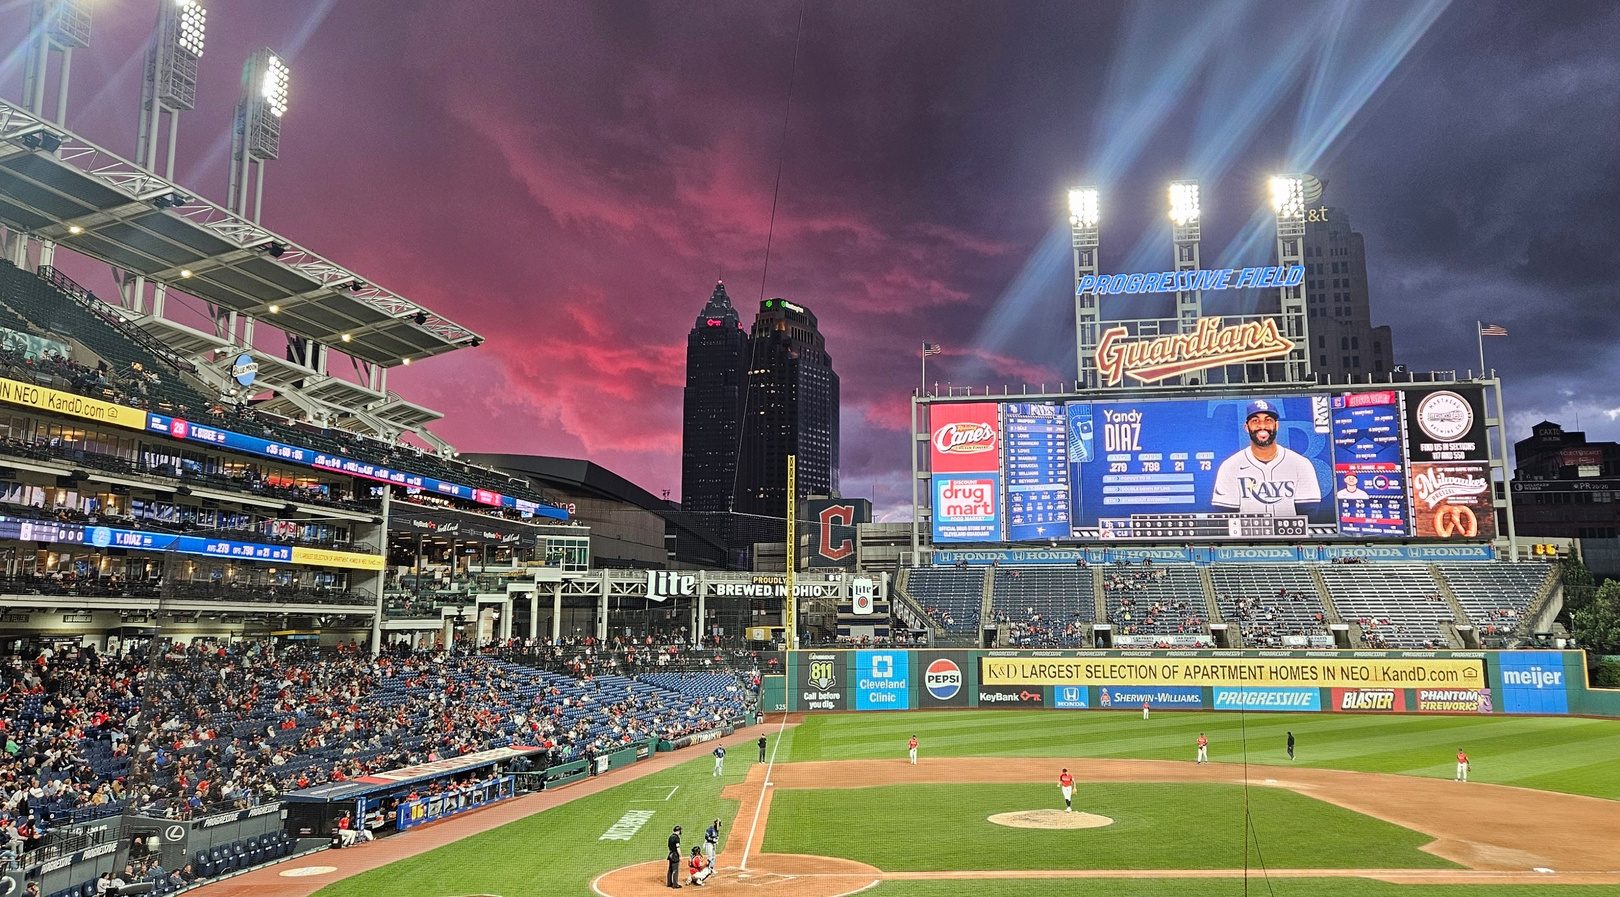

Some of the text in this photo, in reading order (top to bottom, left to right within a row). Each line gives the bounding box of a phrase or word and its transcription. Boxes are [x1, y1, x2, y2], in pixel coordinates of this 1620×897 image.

[1077, 265, 1305, 295] PROGRESSIVE FIELD
[1095, 316, 1295, 386] Guardians
[14, 386, 39, 404] NEO
[48, 392, 105, 418] KandD.com
[1104, 409, 1142, 423] Yandy
[1313, 396, 1330, 428] RAYS
[937, 423, 994, 450] Cane's
[1104, 424, 1142, 451] DIAZ
[1420, 442, 1476, 451] FIND US IN SECTIONS
[1110, 461, 1211, 472] .279 .798 21 73
[1415, 467, 1486, 499] Milwaukee
[943, 480, 984, 503] drug
[1237, 477, 1295, 504] RAYS
[947, 502, 993, 515] mart
[819, 505, 855, 561] C
[953, 552, 1008, 560] HONDA
[1026, 551, 1082, 559] HONDA
[1126, 550, 1185, 558] HONDA
[1233, 549, 1292, 558] HONDA
[1342, 549, 1404, 557] HONDA
[1423, 548, 1487, 556] HONDA
[645, 570, 695, 602] Lite
[753, 577, 787, 585] PROUDLY
[717, 584, 822, 597] BREWED IN OHIO
[855, 585, 872, 596] Lite
[811, 663, 832, 680] 811
[988, 664, 1017, 678] K&D
[1022, 664, 1081, 679] LARGEST
[1085, 664, 1158, 679] SELECTION
[1161, 665, 1179, 679] OF
[1183, 665, 1265, 680] APARTMENT
[1269, 665, 1318, 680] HOMES
[1323, 666, 1336, 680] IN
[1341, 666, 1370, 680] NEO
[1382, 666, 1458, 682] KandD.com
[1504, 667, 1561, 688] meijer
[860, 679, 906, 689] Cleveland
[928, 675, 960, 683] PEPSI
[804, 692, 841, 700] Call before
[869, 693, 896, 702] Clinic
[980, 692, 1019, 702] KeyBank
[1216, 691, 1313, 706] PROGRESSIVE
[1342, 691, 1394, 709] BLASTER
[1420, 690, 1478, 701] PHANTOM
[775, 703, 787, 711] 325
[809, 701, 821, 710] you
[1420, 701, 1478, 711] FIREWORKS
[248, 803, 281, 818] PROGRESSIVE
[204, 812, 240, 828] PROGRESSIVE
[82, 842, 118, 861] PROGRESSIVE
[40, 855, 74, 875] PROGRESSIVE
